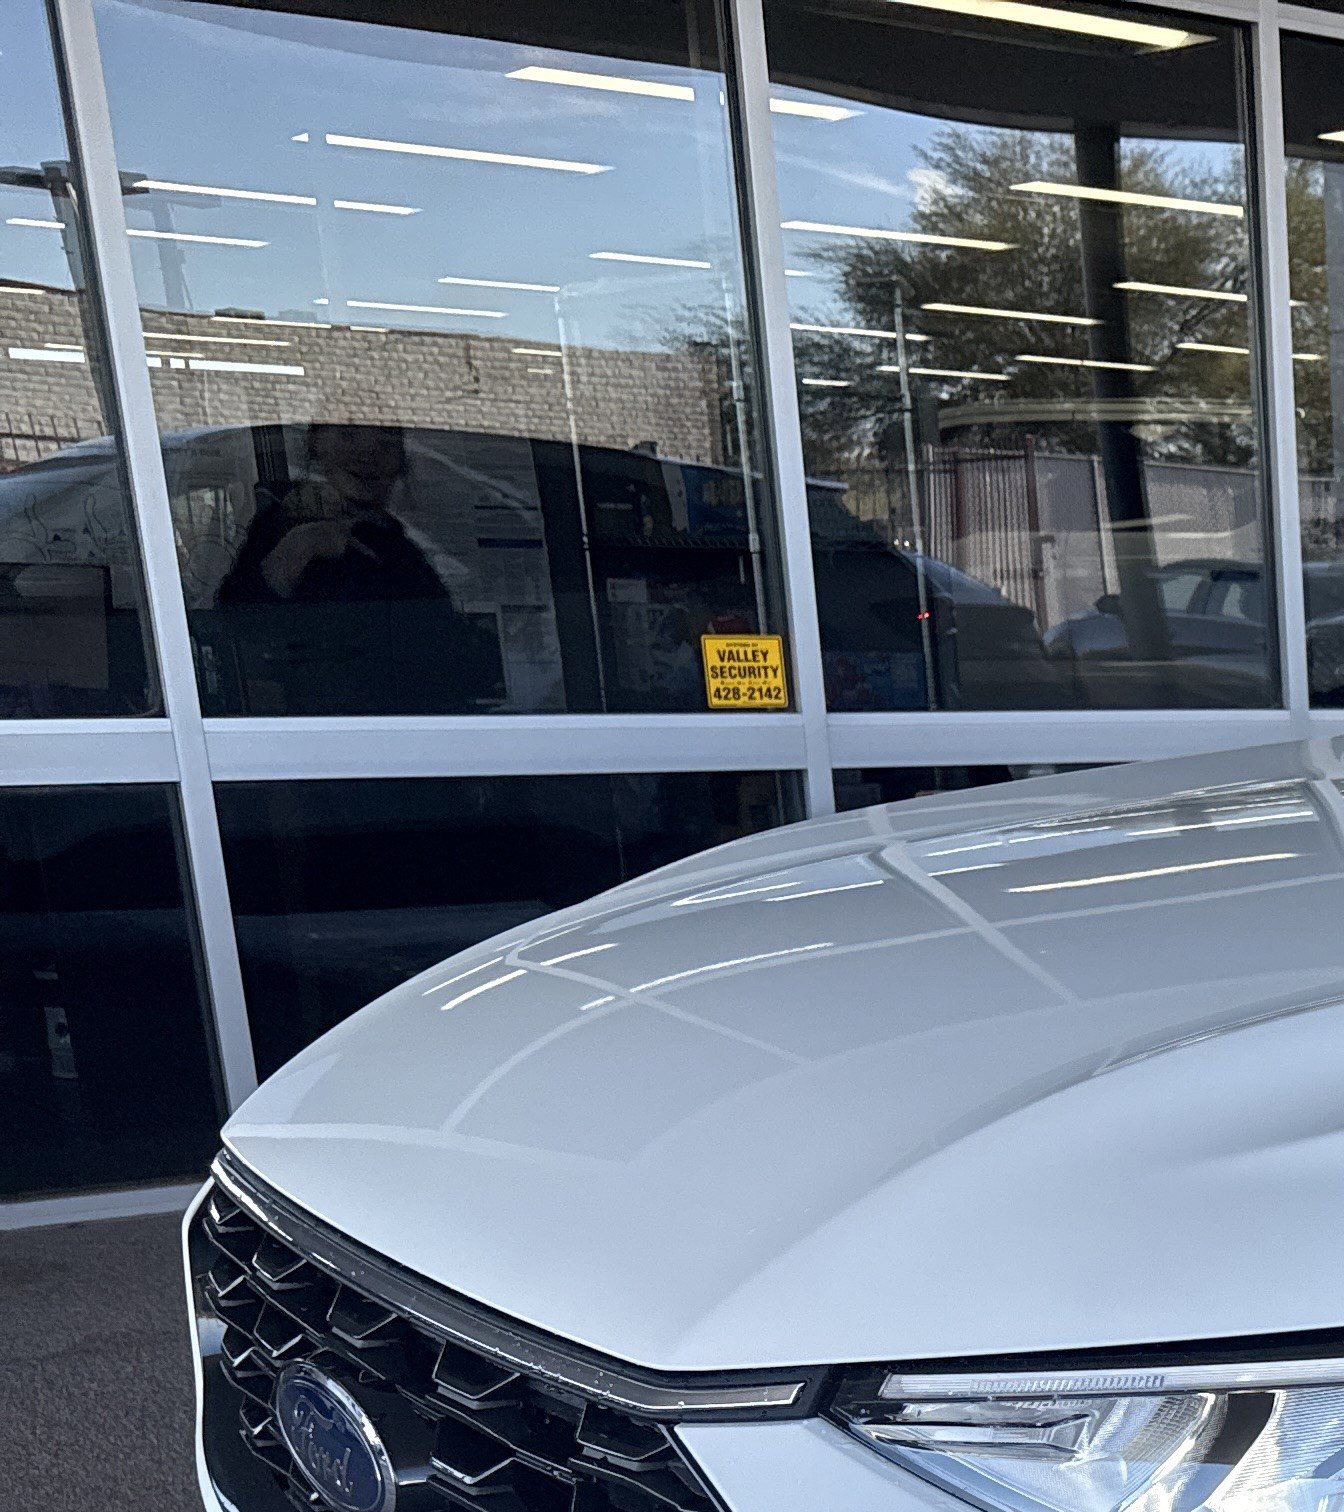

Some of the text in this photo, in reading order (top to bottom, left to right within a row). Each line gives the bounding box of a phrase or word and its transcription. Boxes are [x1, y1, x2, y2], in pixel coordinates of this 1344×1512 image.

[716, 649, 769, 663] VALLEY
[710, 666, 779, 679] SECURITY
[713, 686, 782, 701] 428-2142
